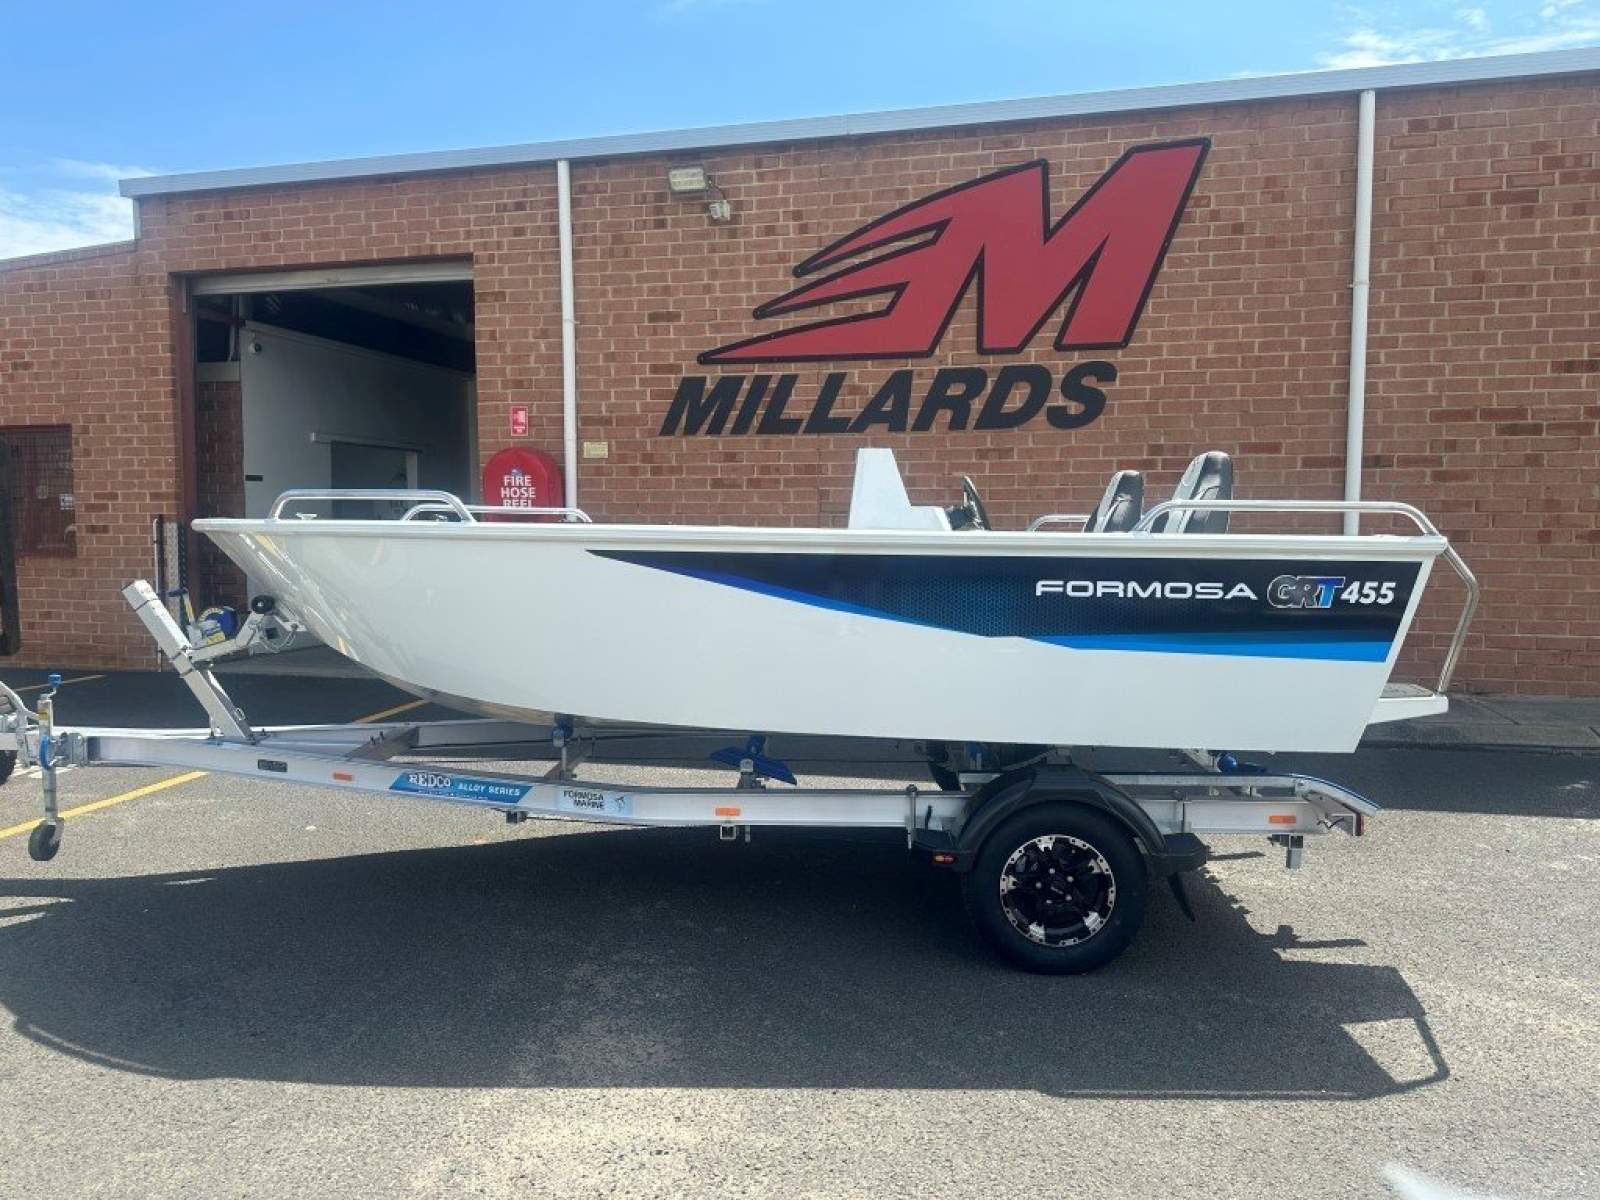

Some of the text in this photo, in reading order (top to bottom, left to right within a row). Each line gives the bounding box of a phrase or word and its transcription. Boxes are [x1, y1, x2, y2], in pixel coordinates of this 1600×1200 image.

[659, 361, 1118, 437] MILLARDS
[503, 475, 533, 486] FIRE
[501, 487, 536, 498] HOSE
[1035, 574, 1396, 609] FORMOSA GRT 455
[457, 782, 485, 793] ALLOY
[488, 784, 521, 796] SERIES
[563, 789, 604, 801] FORMOSA
[573, 799, 605, 809] MARINE
